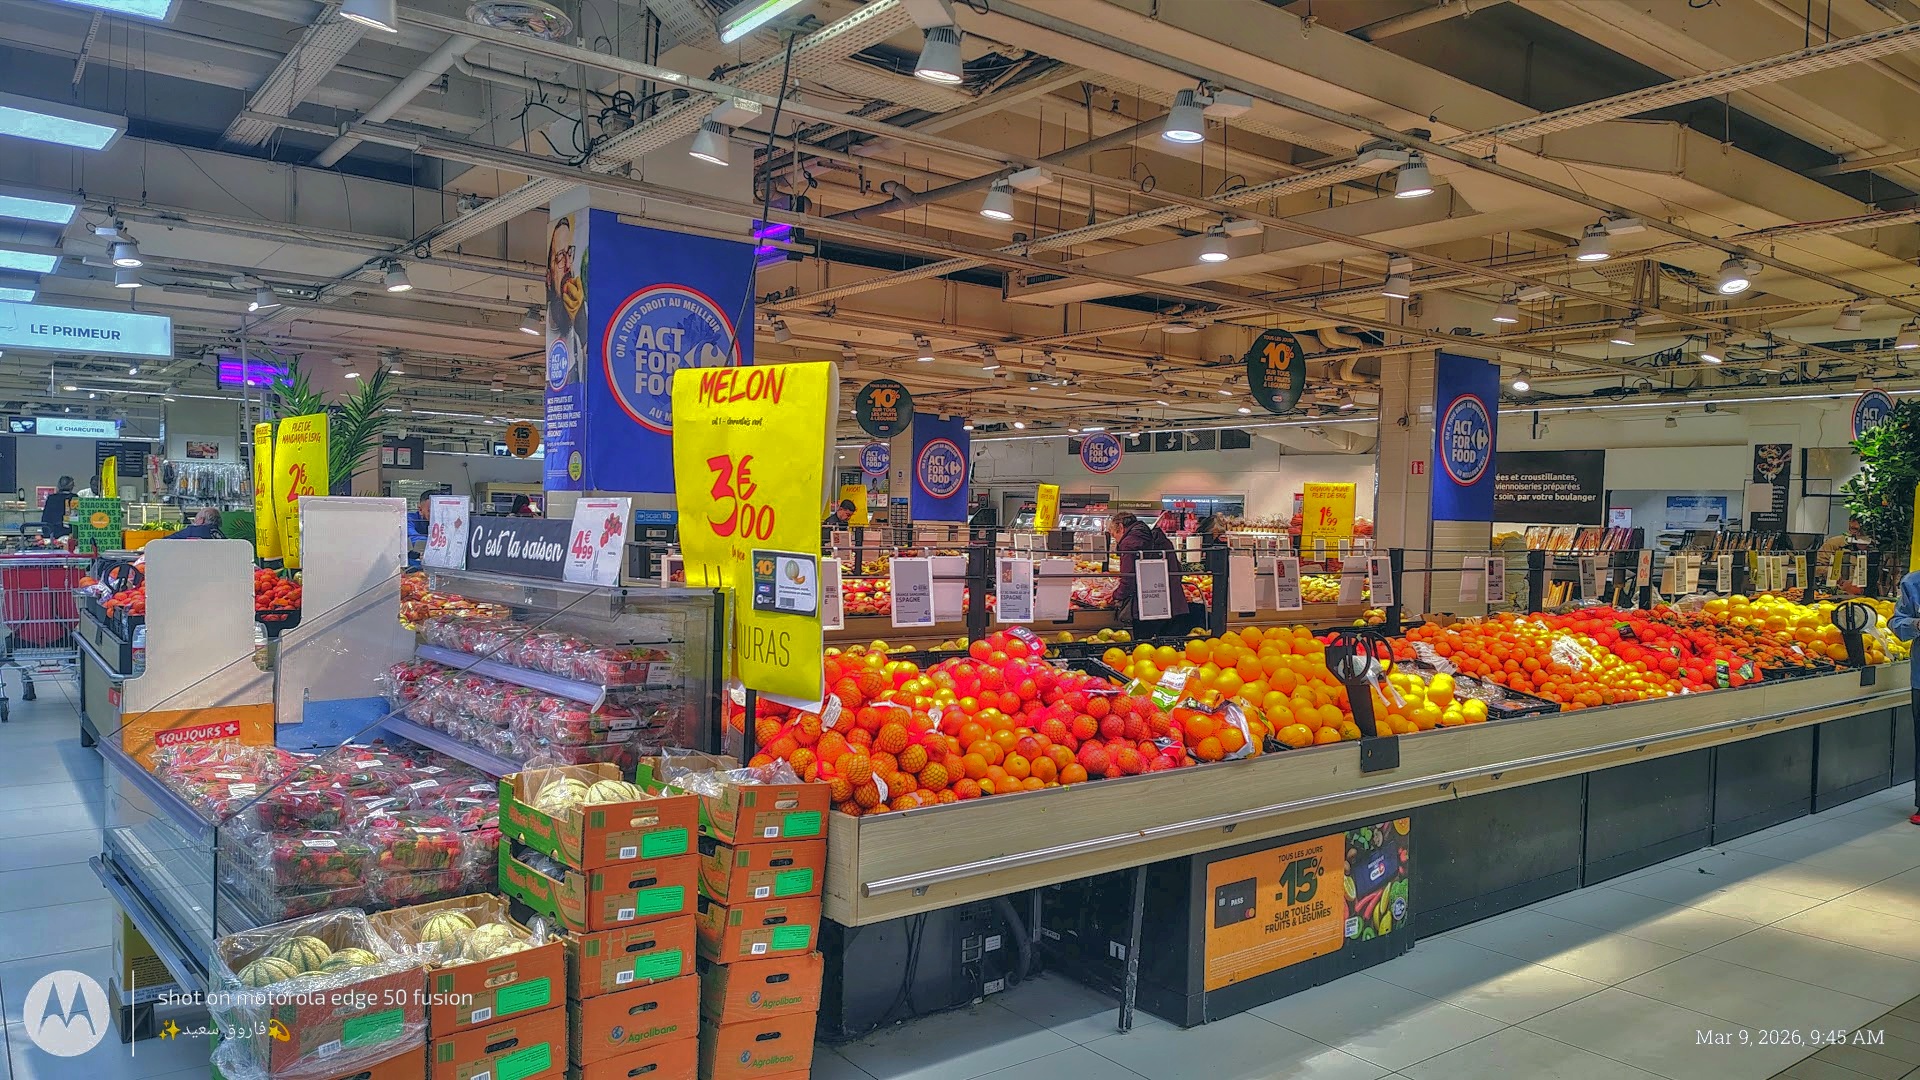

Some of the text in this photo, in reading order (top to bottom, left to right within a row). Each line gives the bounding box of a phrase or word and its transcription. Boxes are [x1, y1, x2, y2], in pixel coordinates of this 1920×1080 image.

[30, 324, 121, 341] LE PRIMEUR
[616, 298, 720, 358] ON A TOUS DROIT AU MEILLEUR
[636, 324, 684, 352] ACT
[636, 350, 681, 374] FOR
[1261, 342, 1294, 370] -10%
[636, 372, 673, 396] FOO
[699, 367, 786, 408] MELON
[868, 388, 900, 407] -10%
[649, 407, 661, 419] AU
[1862, 408, 1879, 420] ACT
[1454, 420, 1472, 435] ACT
[1452, 436, 1470, 449] FOR
[929, 456, 946, 466] ACT
[1452, 448, 1476, 464] FOOD
[928, 465, 944, 474] FOR
[1520, 473, 1577, 482] croustillantes,
[928, 474, 950, 484] FOOD
[1495, 482, 1580, 492] viennoiseries préparées
[1498, 493, 1516, 501] soin,
[1555, 493, 1596, 502] boulanger
[1320, 506, 1337, 526] 1€99
[522, 539, 563, 562] saison
[158, 726, 220, 744] TOUJOURS
[1278, 846, 1324, 863] TOUS LES JOURS
[1275, 856, 1324, 906] -15%
[1230, 897, 1244, 907] PASS
[1275, 901, 1324, 922] SUR TOUS LES
[1265, 920, 1291, 935] FRUITS
[1292, 918, 1298, 928] &
[762, 994, 803, 1009] Agrolibano
[628, 1024, 677, 1044] Agrolibano
[753, 1053, 794, 1068] Agrolibano
